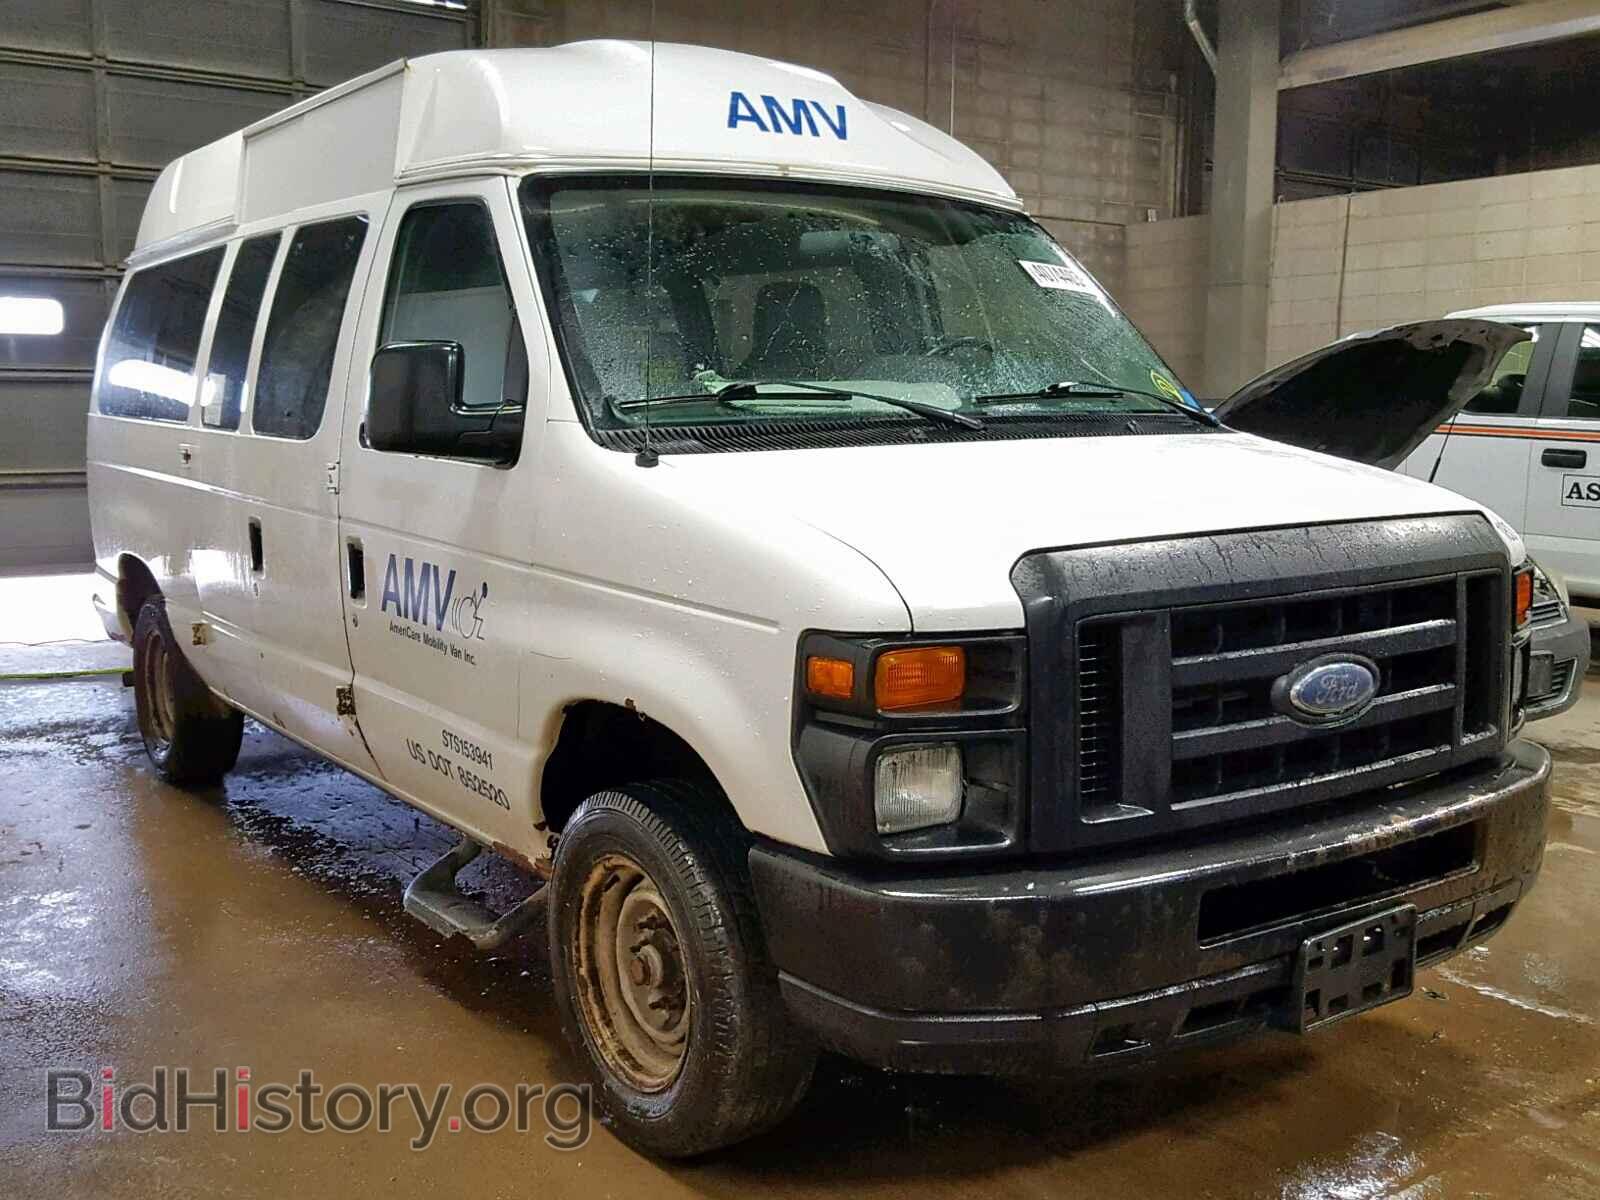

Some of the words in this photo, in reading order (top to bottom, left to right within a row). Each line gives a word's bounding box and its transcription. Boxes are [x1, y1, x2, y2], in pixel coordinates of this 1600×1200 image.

[727, 91, 847, 140] AMV
[381, 553, 456, 632] AMV
[389, 620, 421, 642] AmeriCare
[423, 632, 448, 656] Mobility
[449, 641, 463, 660] Van
[1313, 674, 1360, 704] Ford
[442, 729, 493, 771] STS153941
[406, 738, 426, 765] US
[427, 749, 455, 780] DOT
[457, 766, 511, 811] 852520
